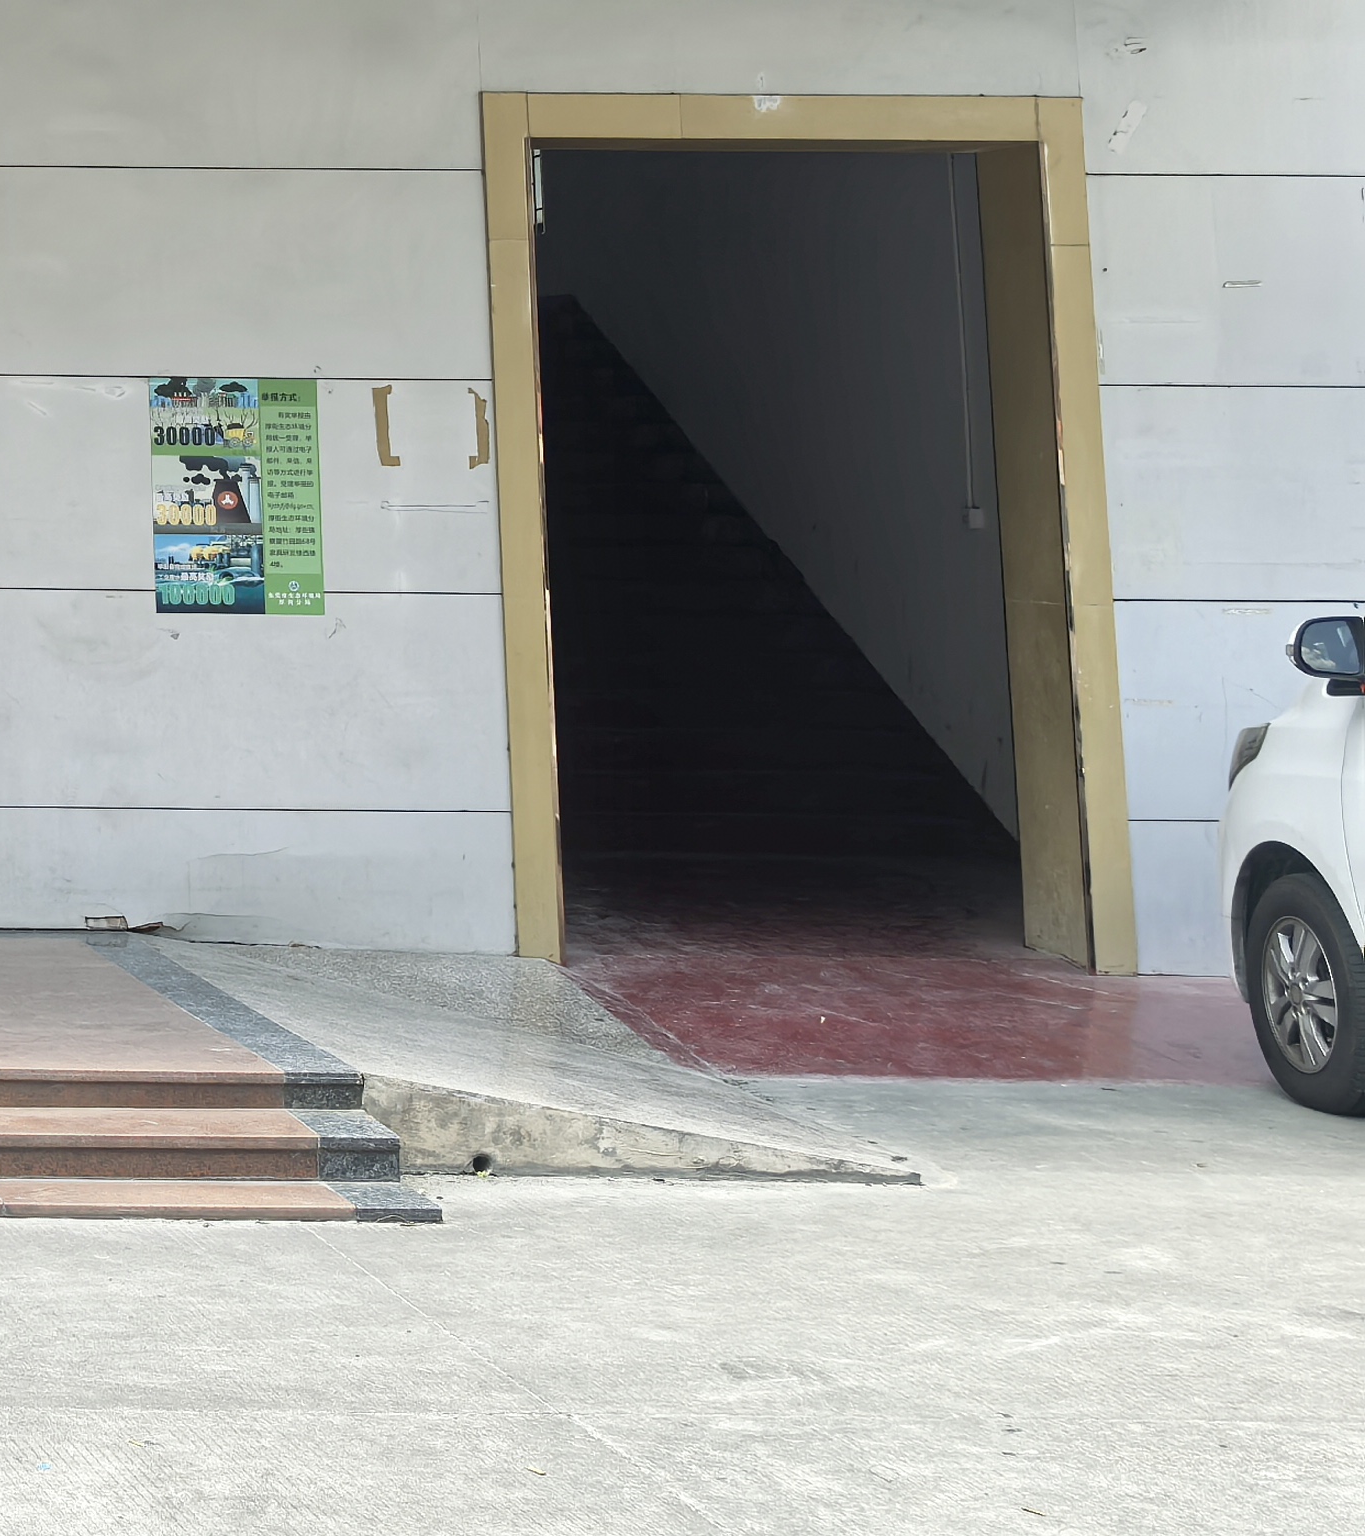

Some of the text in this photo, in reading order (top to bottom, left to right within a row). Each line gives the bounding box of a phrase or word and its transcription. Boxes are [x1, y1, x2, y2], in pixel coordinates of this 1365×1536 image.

[153, 425, 215, 446] 30000
[156, 503, 217, 526] 30000
[157, 583, 236, 606] 100000
